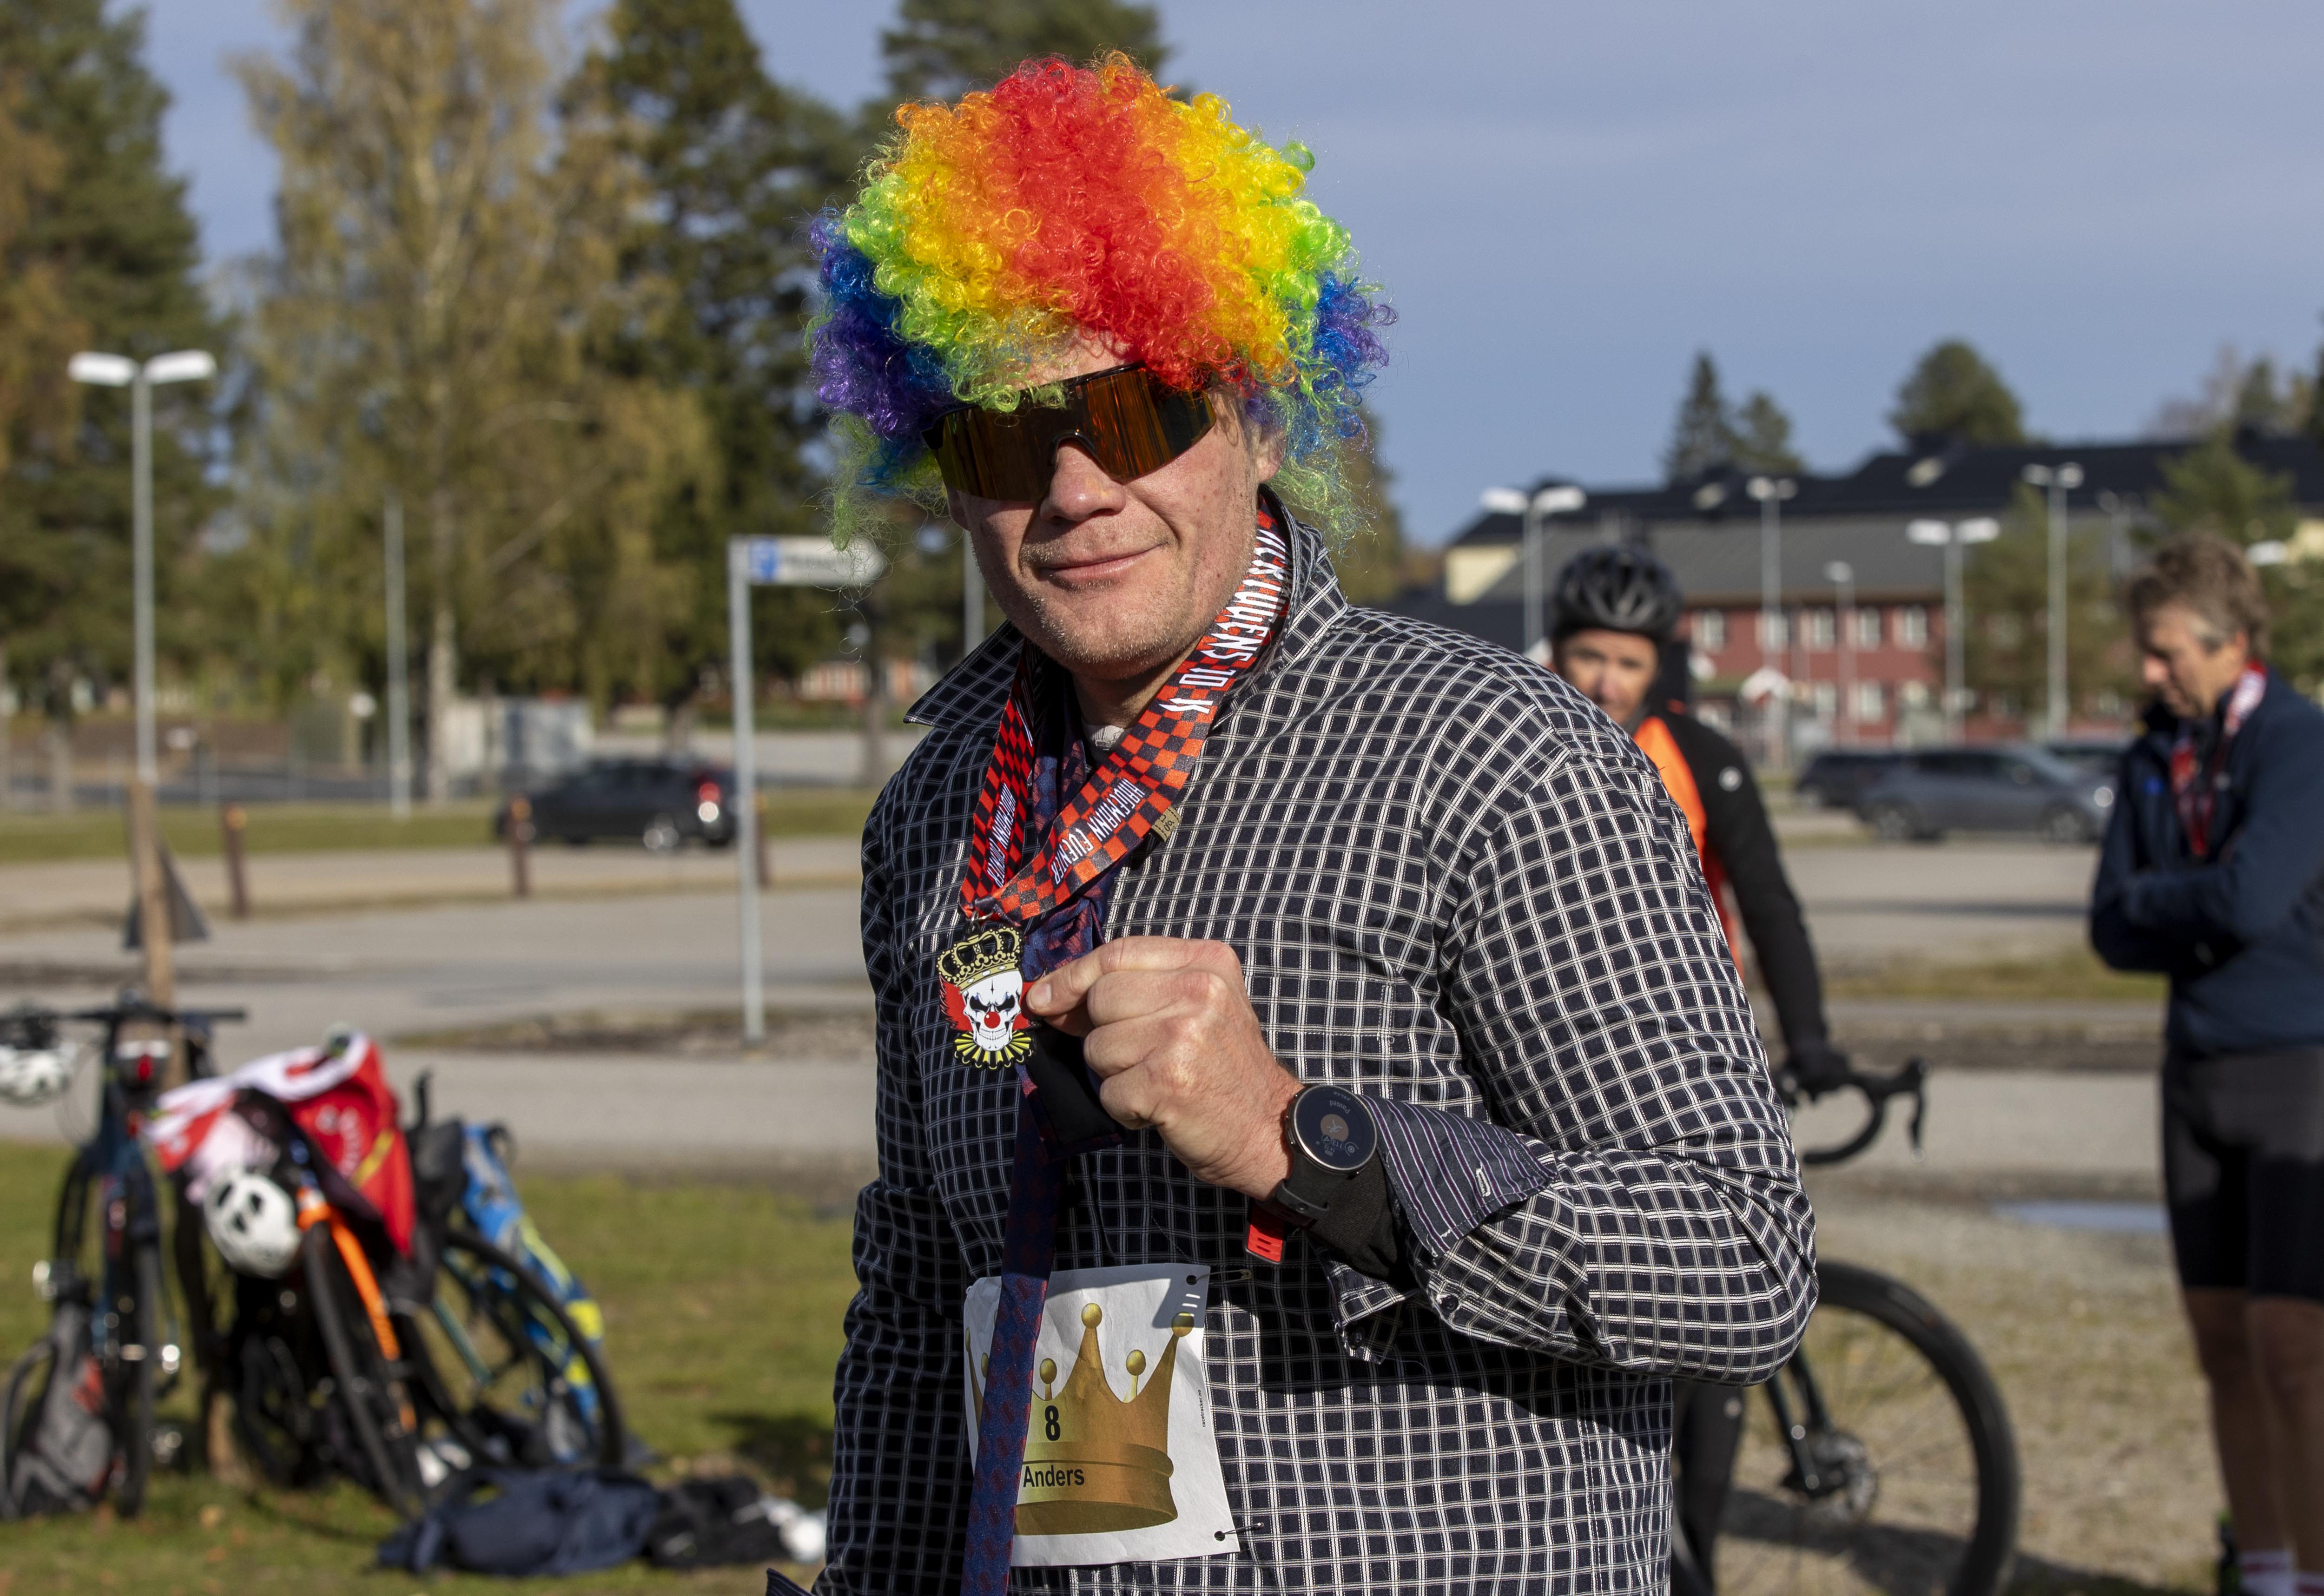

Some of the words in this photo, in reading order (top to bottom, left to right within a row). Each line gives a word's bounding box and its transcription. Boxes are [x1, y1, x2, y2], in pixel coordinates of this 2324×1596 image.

[1178, 666, 1237, 688] 10
[1158, 697, 1214, 715] K
[991, 782, 1017, 850] HAGEMANN
[1086, 778, 1145, 842] HAGEMANN
[1329, 1100, 1351, 1114] Paused
[1044, 1405, 1061, 1441] 8
[1198, 1389, 1206, 1427] racetracker.no
[1023, 1464, 1085, 1488] Anders
